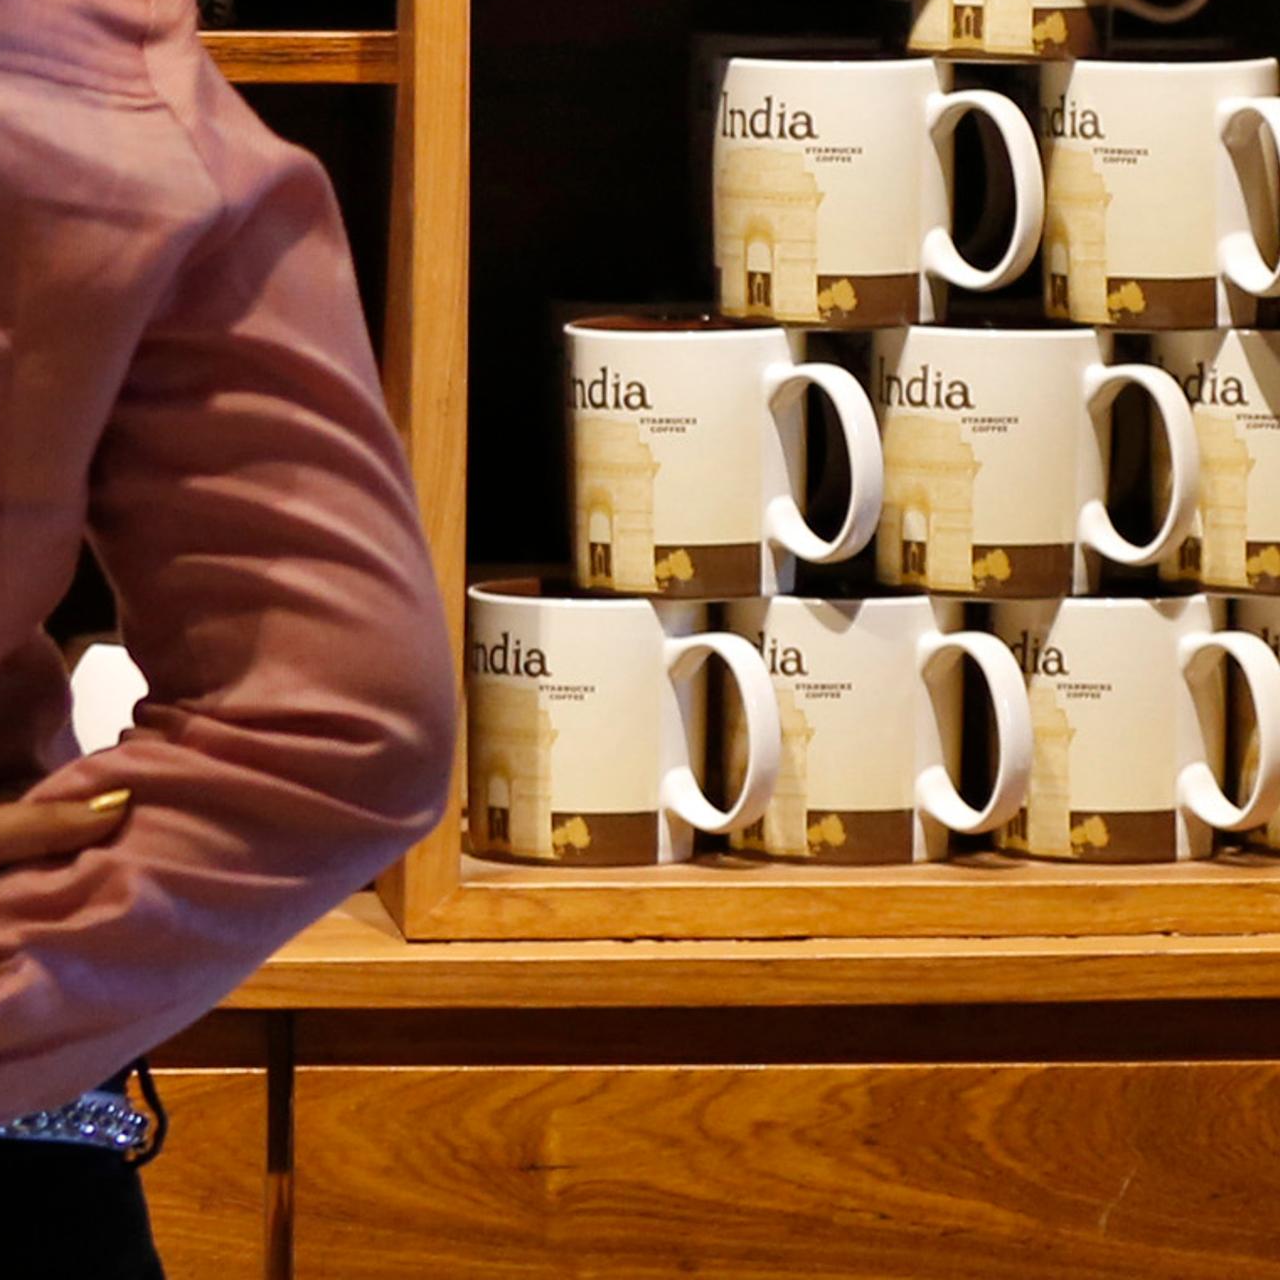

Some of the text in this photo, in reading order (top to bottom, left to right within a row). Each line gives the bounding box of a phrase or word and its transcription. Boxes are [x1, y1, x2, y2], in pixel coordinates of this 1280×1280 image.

[721, 92, 819, 140] India
[570, 365, 653, 410] ndia
[1183, 361, 1250, 407] dia
[470, 632, 552, 677] ndia
